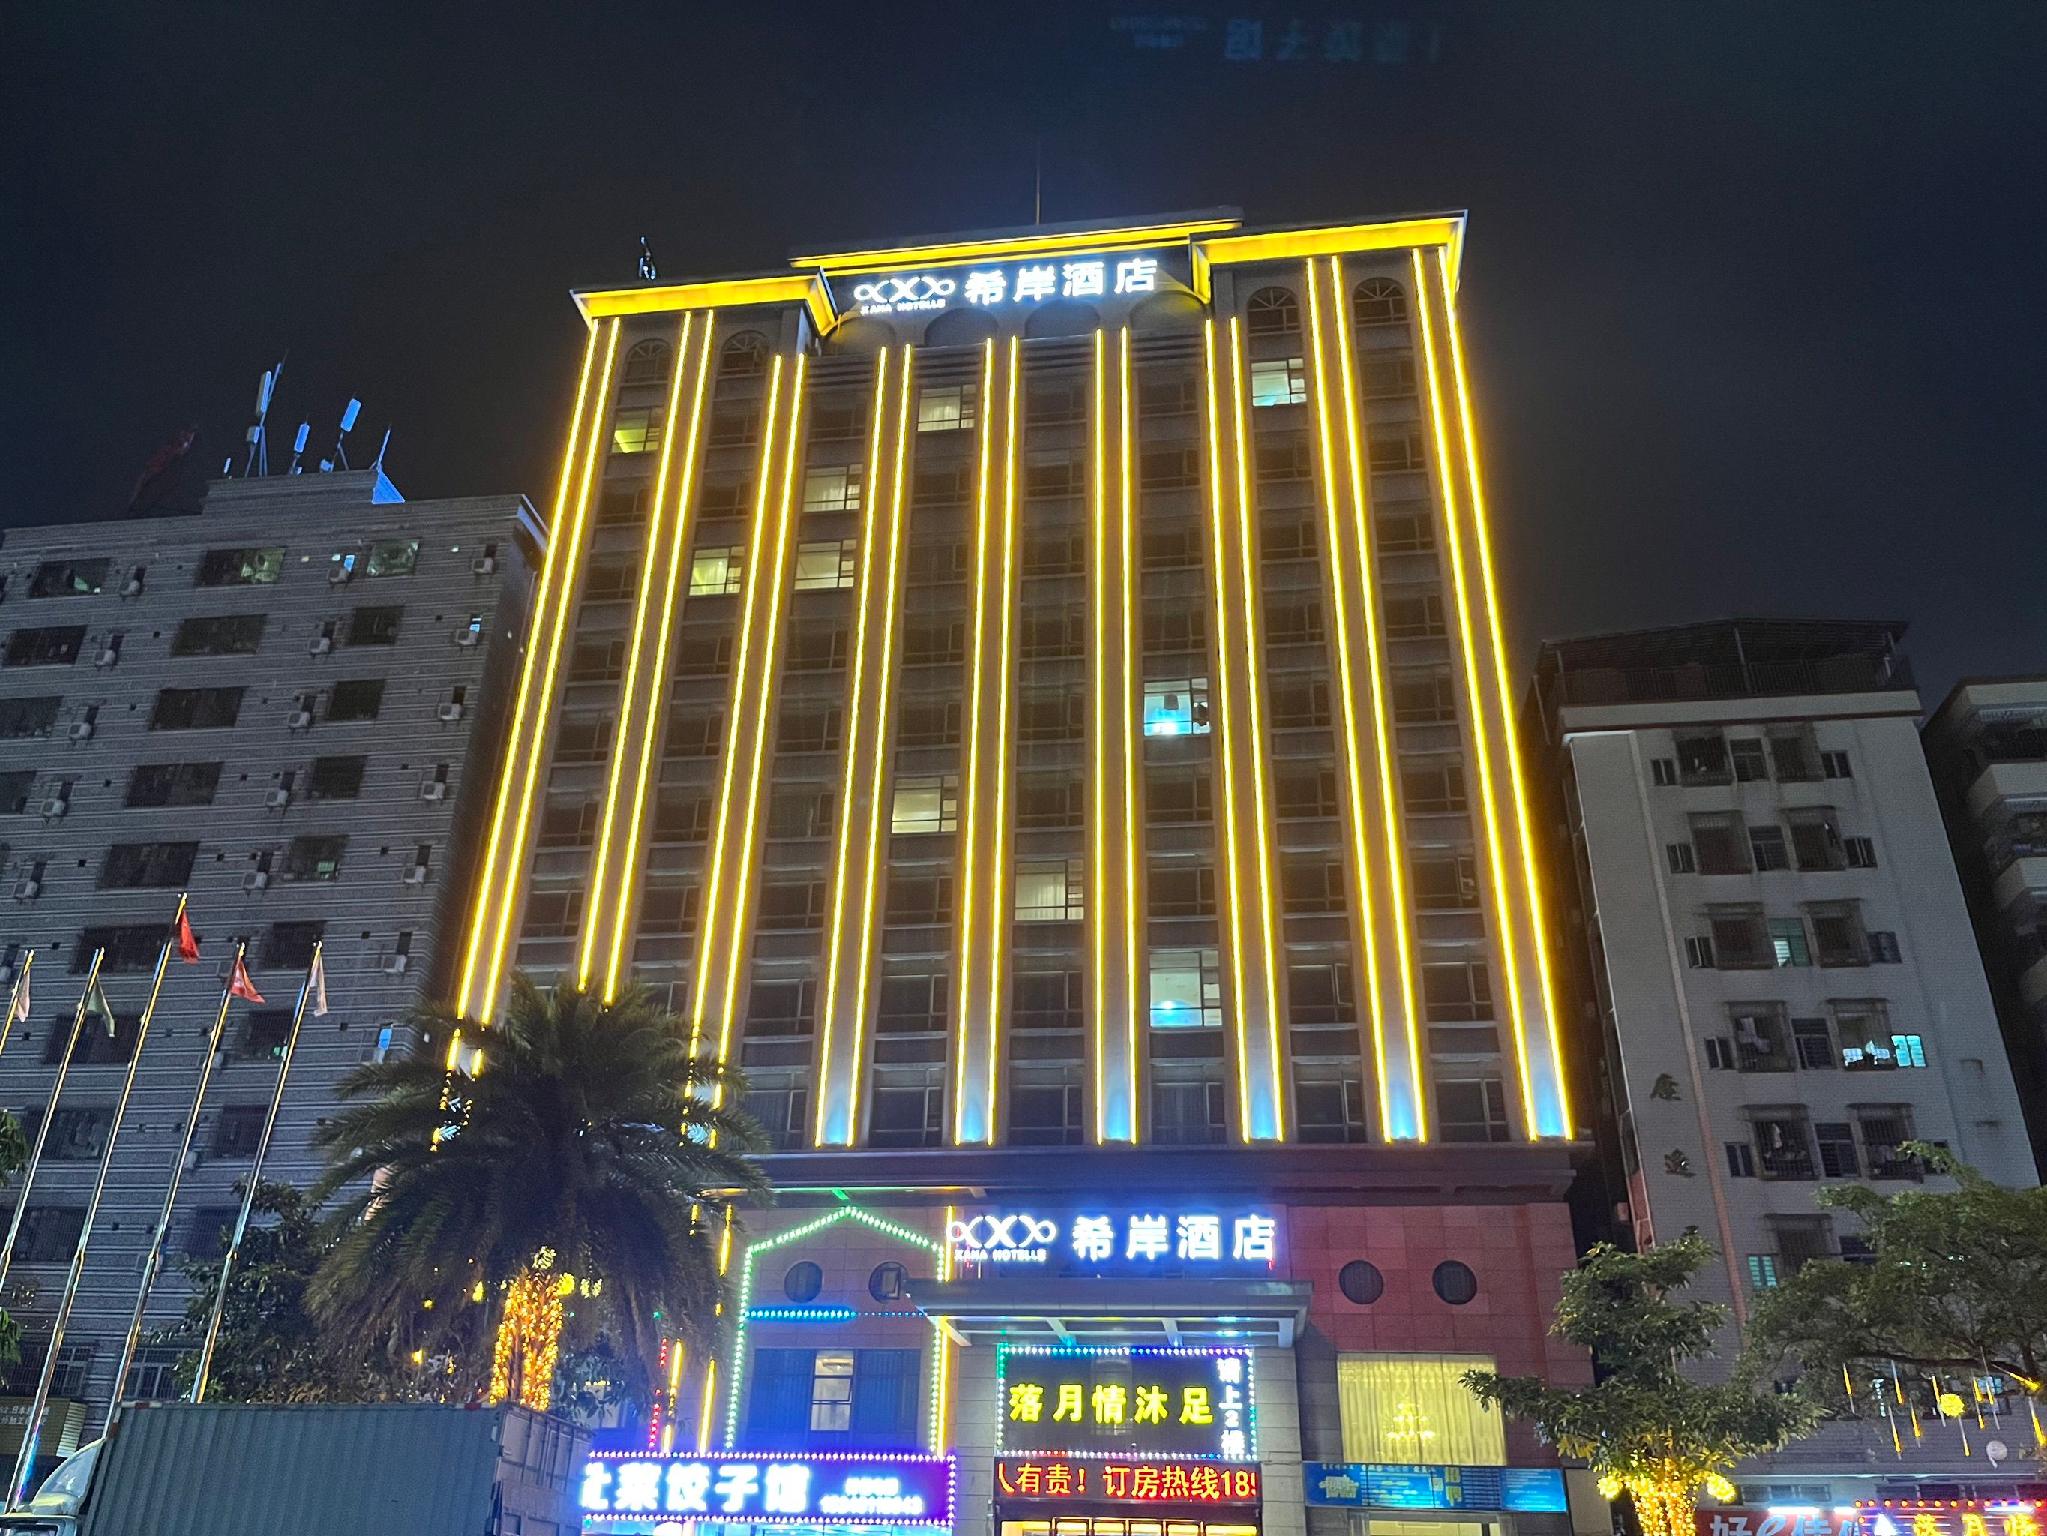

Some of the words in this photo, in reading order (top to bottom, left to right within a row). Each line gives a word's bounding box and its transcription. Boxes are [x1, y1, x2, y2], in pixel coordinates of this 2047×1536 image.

[964, 258, 1159, 305] 希岸酒店
[1072, 1214, 1276, 1261] 希岸酒店
[1009, 1383, 1213, 1424] 落月情沐足
